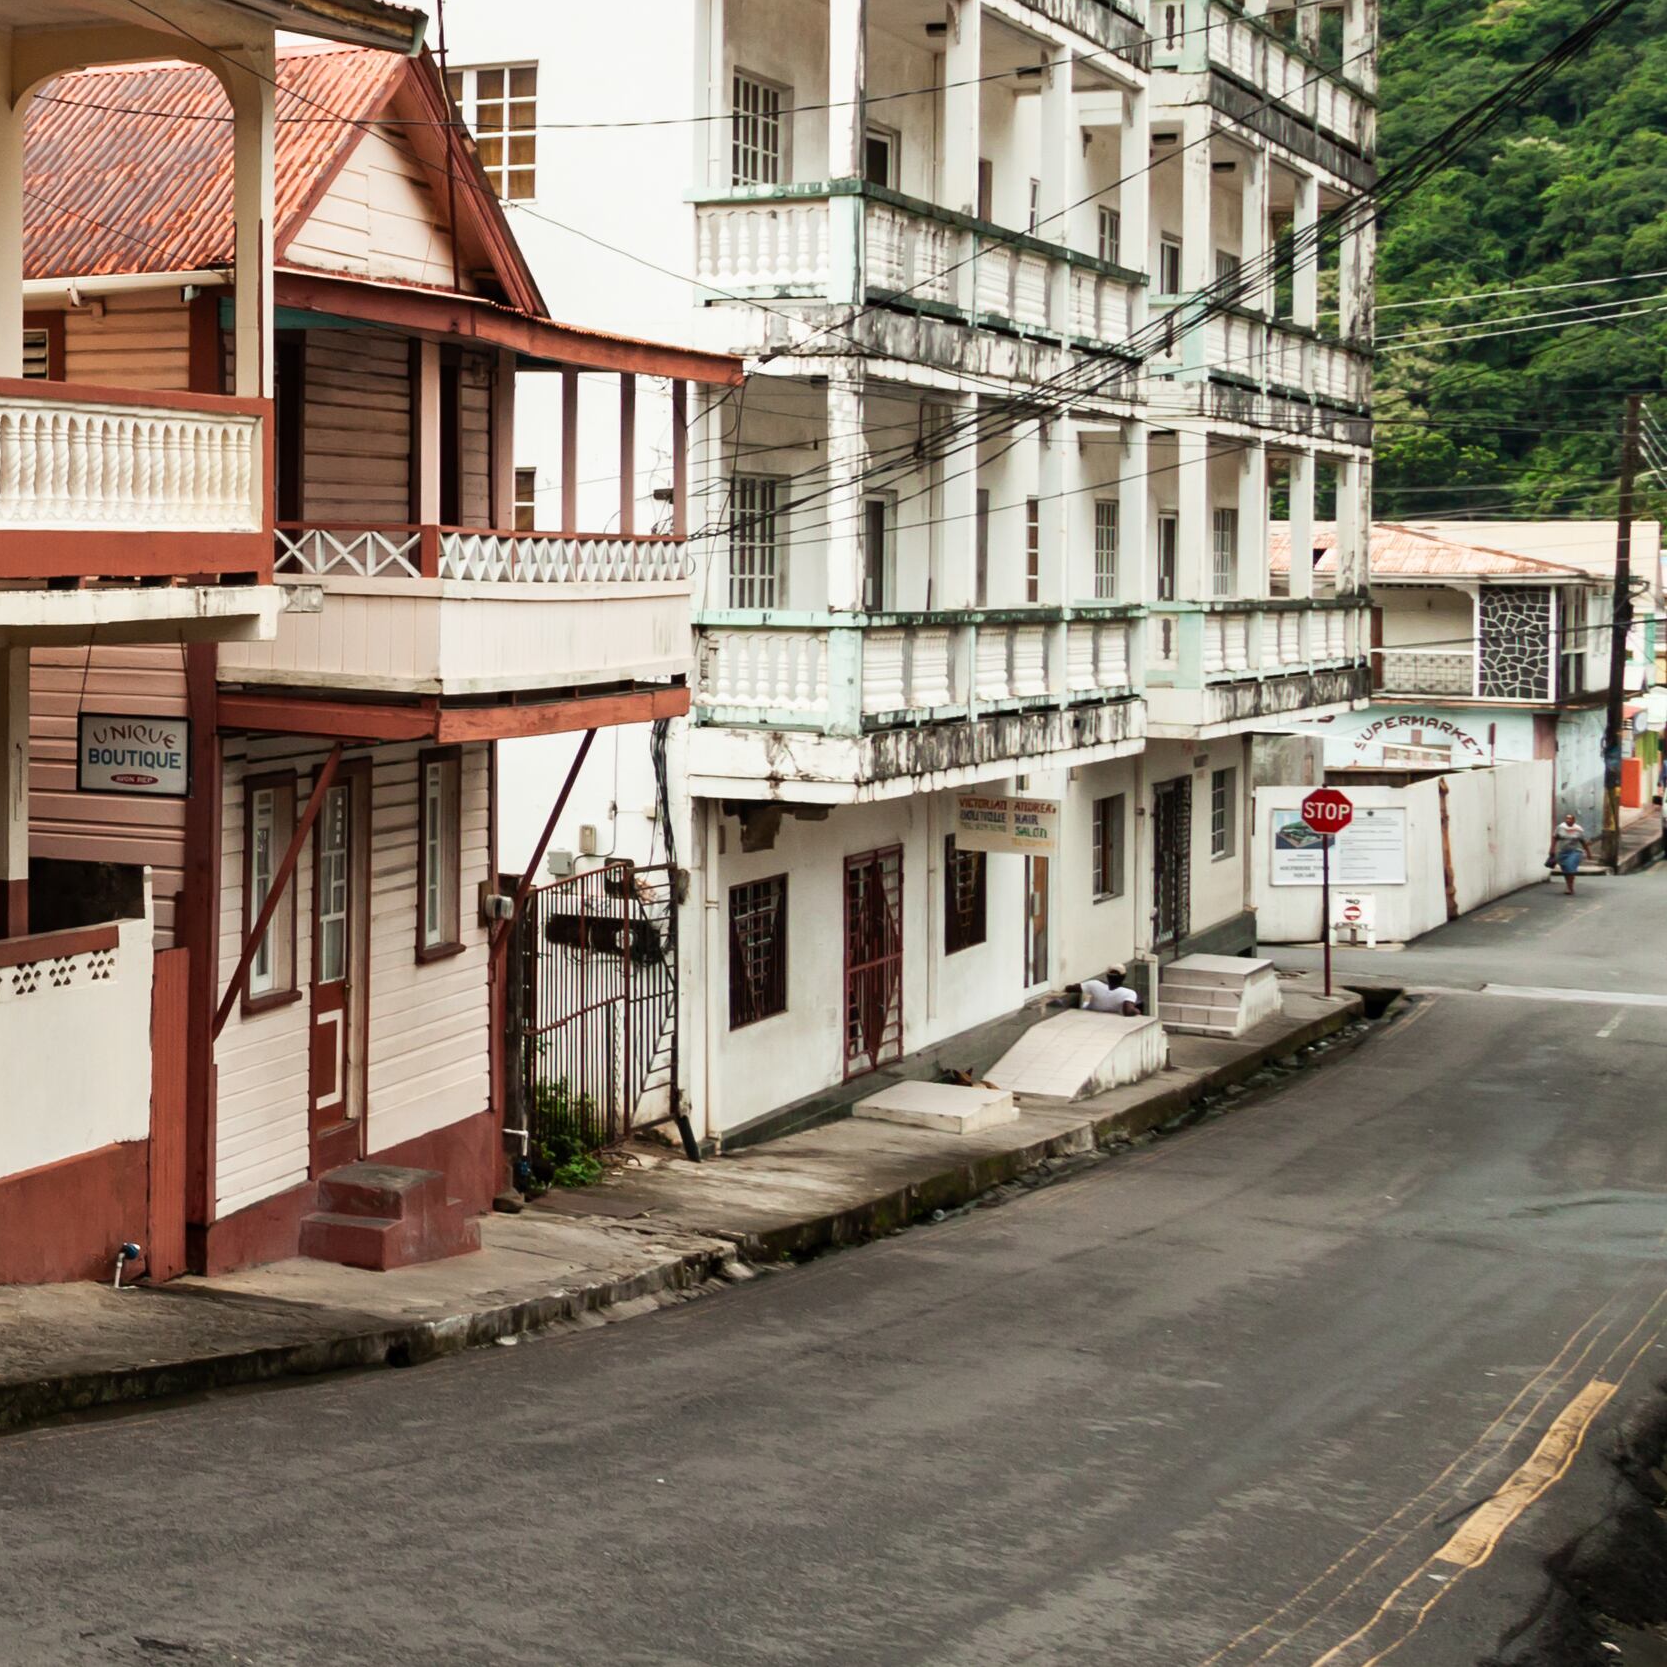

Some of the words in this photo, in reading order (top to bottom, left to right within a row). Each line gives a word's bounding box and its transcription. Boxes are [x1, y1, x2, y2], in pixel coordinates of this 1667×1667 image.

[93, 724, 177, 749] UNIQUE
[88, 747, 181, 769] BOUTIQUE
[1014, 813, 1039, 825] HAIR
[1304, 802, 1351, 820] STOP
[1015, 826, 1047, 838] SALON
